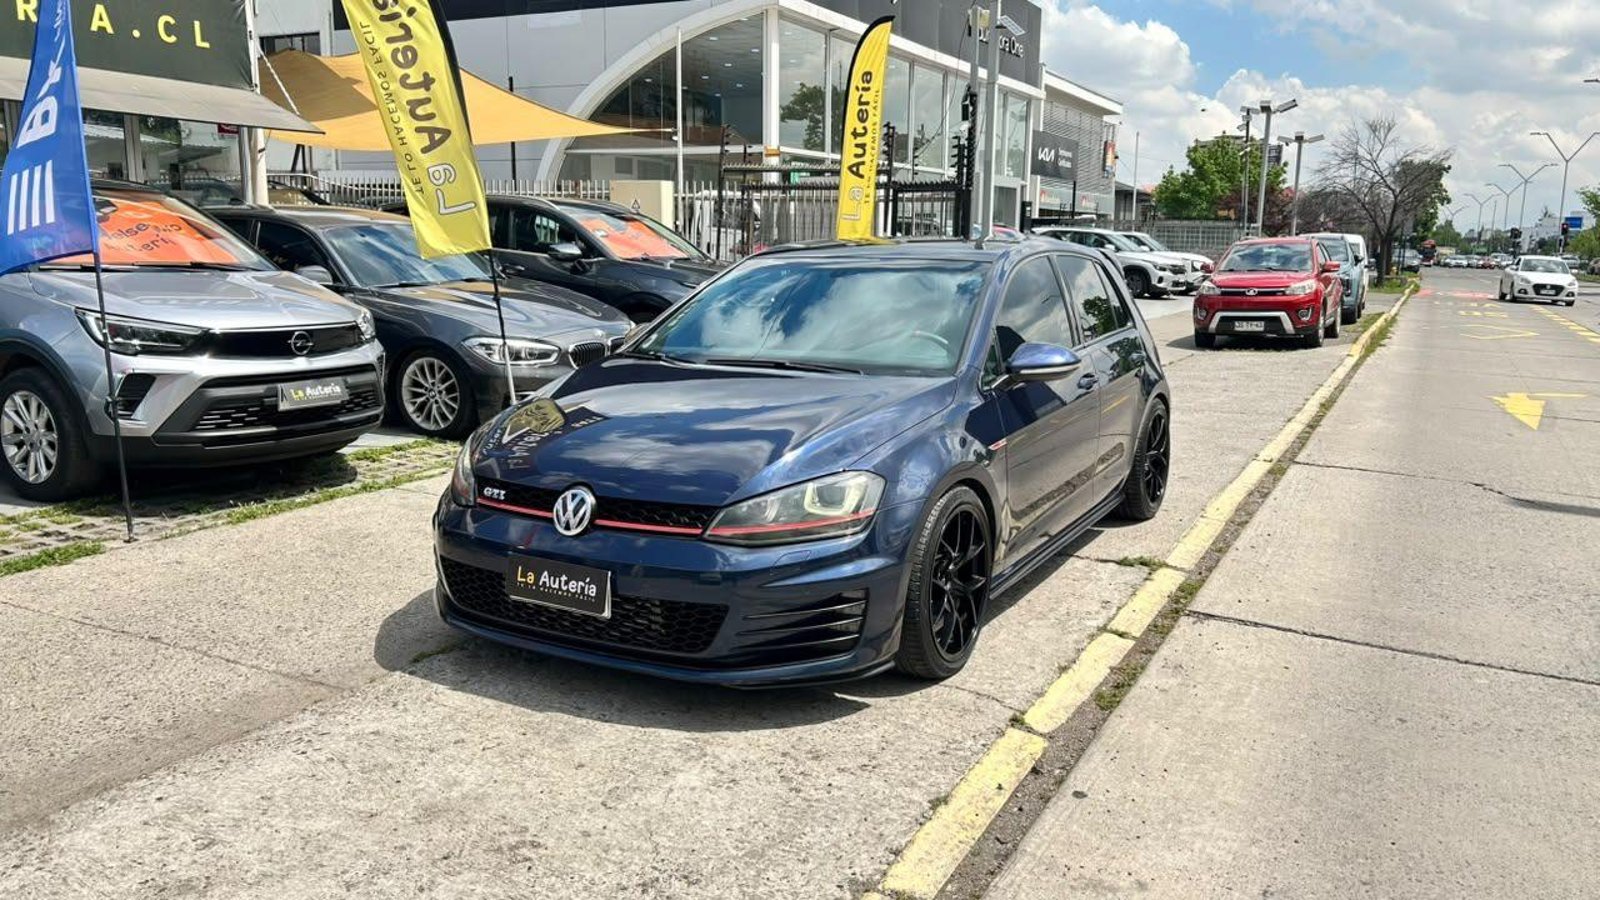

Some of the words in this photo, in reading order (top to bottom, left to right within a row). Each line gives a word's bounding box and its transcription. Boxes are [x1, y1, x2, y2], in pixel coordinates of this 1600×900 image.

[847, 71, 873, 179] Autería
[483, 487, 506, 500] GTI
[517, 565, 535, 584] La
[539, 570, 597, 597] Autería
